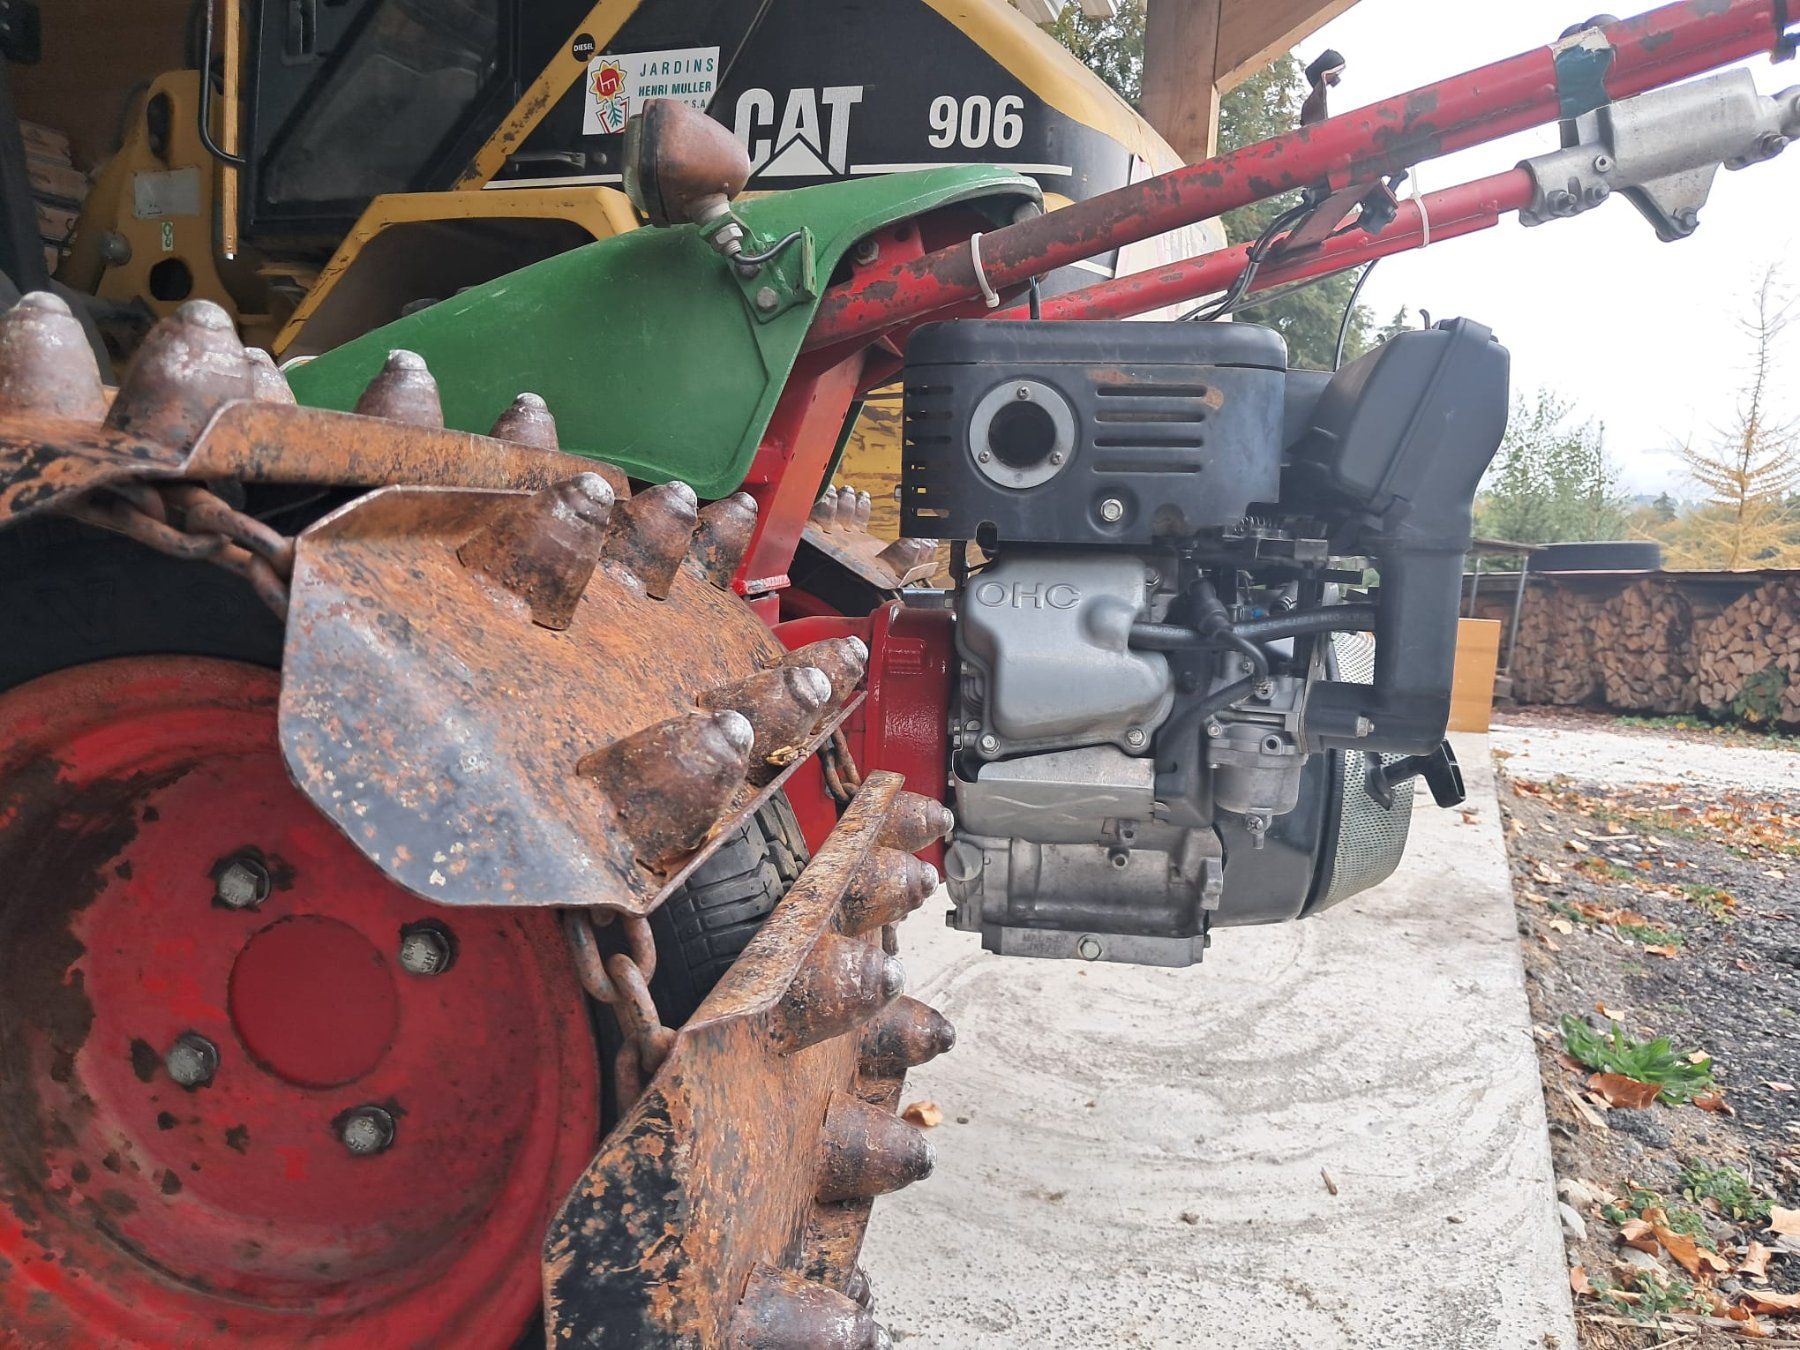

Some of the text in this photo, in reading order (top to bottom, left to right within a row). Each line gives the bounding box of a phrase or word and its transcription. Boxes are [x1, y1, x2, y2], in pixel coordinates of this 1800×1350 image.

[573, 43, 594, 52] DIESEL
[640, 57, 714, 77] JARDINS
[638, 81, 711, 97] HENRI MULLER
[734, 85, 863, 177] CAT
[928, 94, 1025, 149] 906
[976, 581, 1082, 610] OHC
